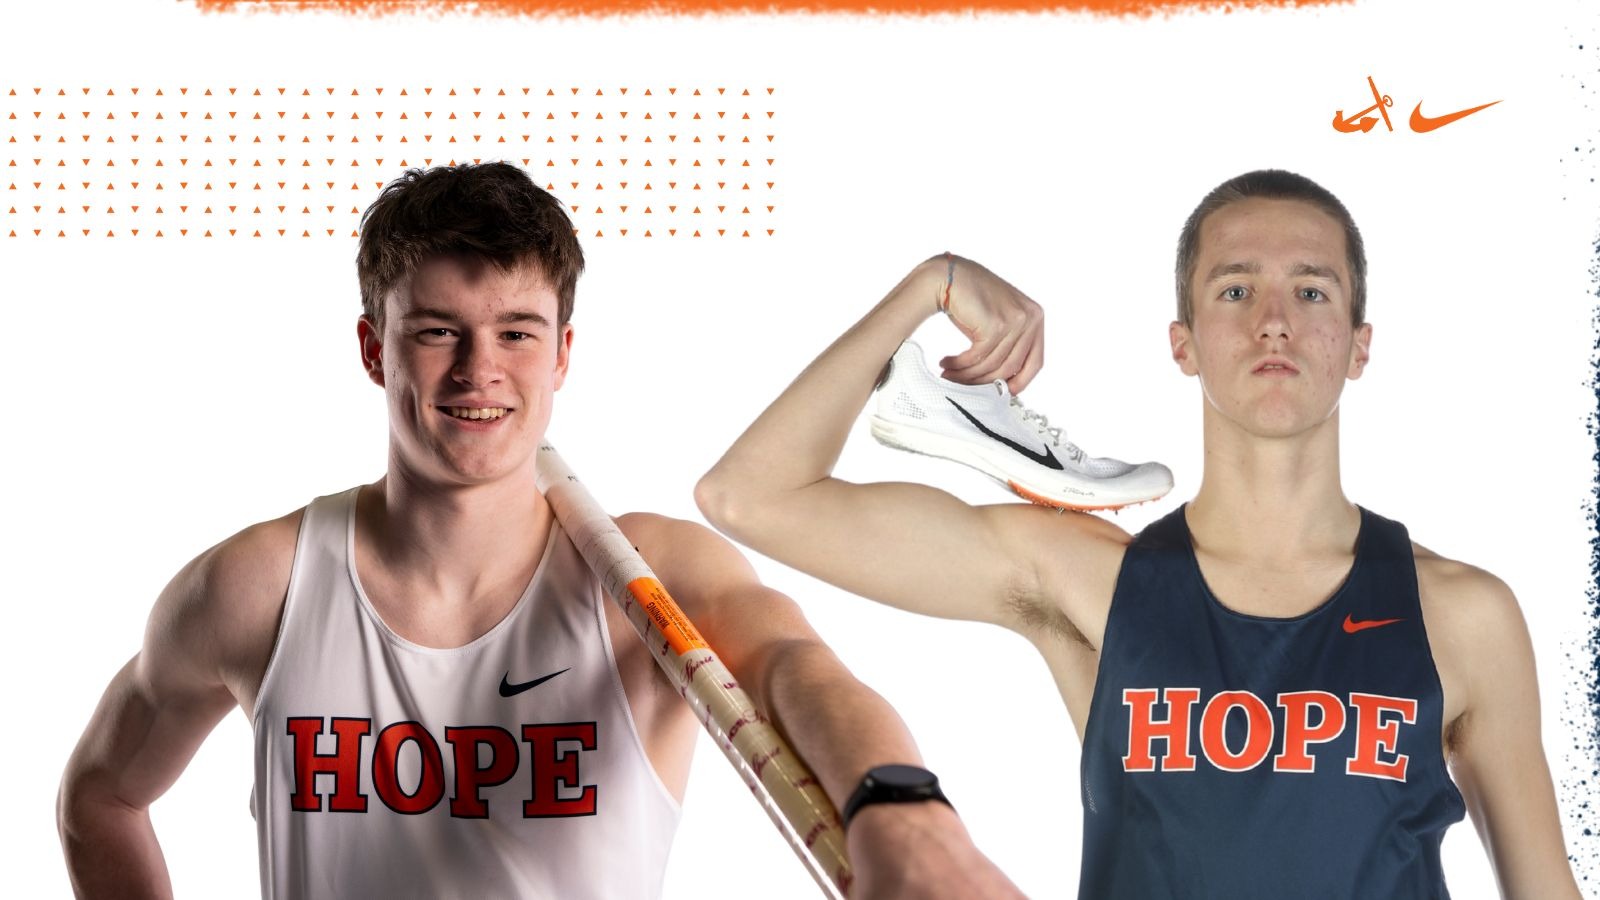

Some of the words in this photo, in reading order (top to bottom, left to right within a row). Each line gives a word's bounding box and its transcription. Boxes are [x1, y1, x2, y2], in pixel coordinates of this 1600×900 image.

[646, 602, 669, 630] WARNING
[286, 716, 598, 819] HOPE
[1122, 688, 1418, 783] HOPE
